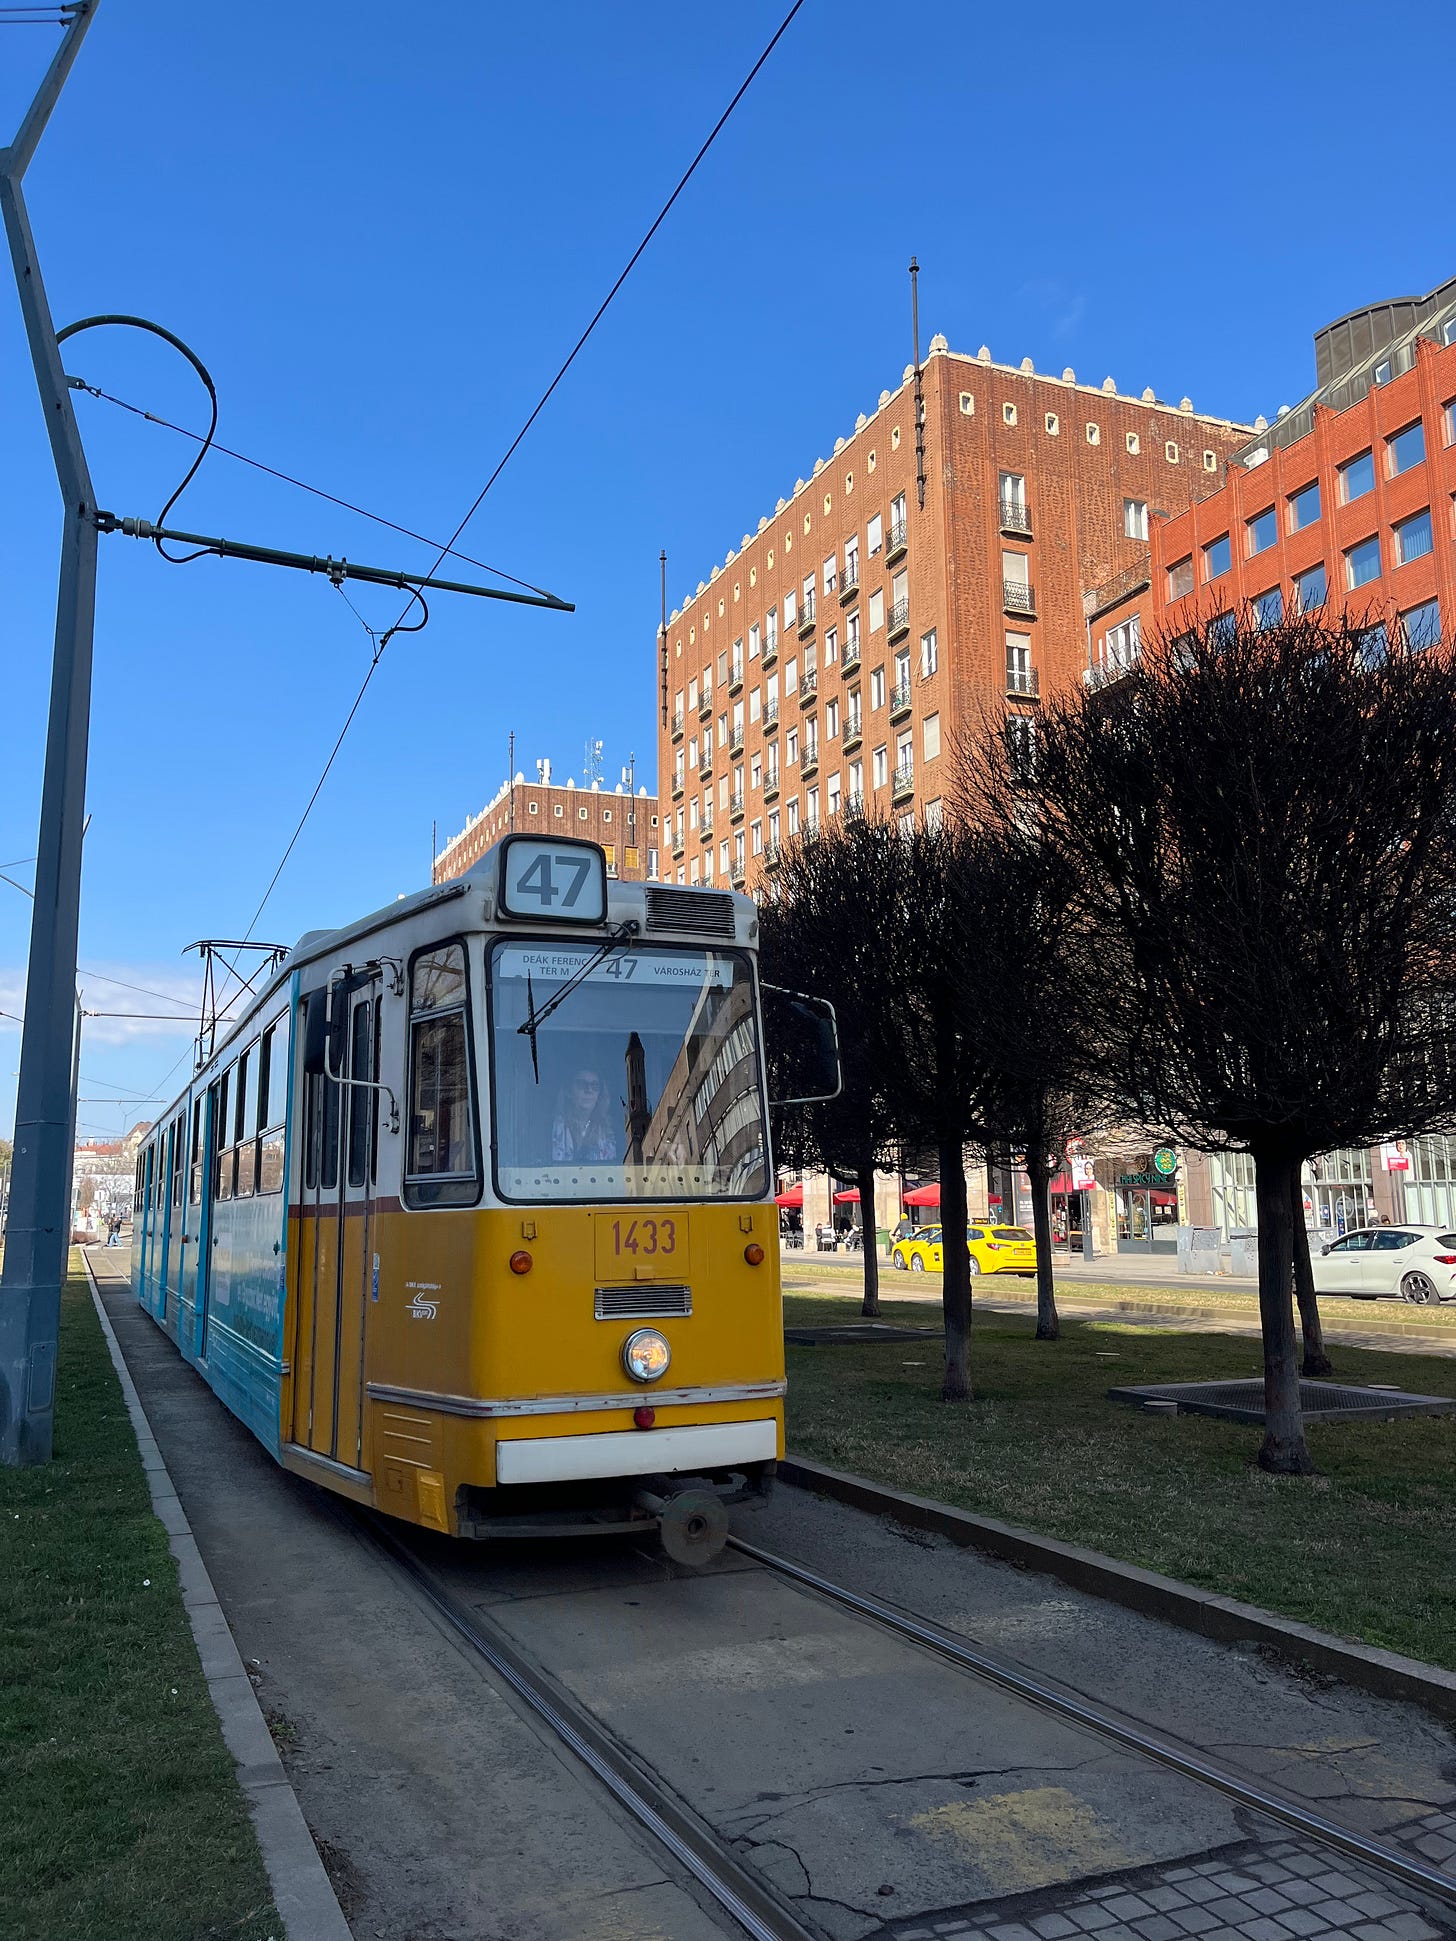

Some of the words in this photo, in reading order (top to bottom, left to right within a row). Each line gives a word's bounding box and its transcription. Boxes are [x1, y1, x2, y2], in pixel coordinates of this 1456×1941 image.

[517, 854, 591, 907] 47
[522, 953, 550, 965] DEÁK
[552, 956, 587, 967] FERENC
[606, 958, 638, 979] 47
[560, 968, 570, 976] M
[654, 965, 702, 977] VÁROSHÁZ
[612, 1219, 676, 1256] 1433
